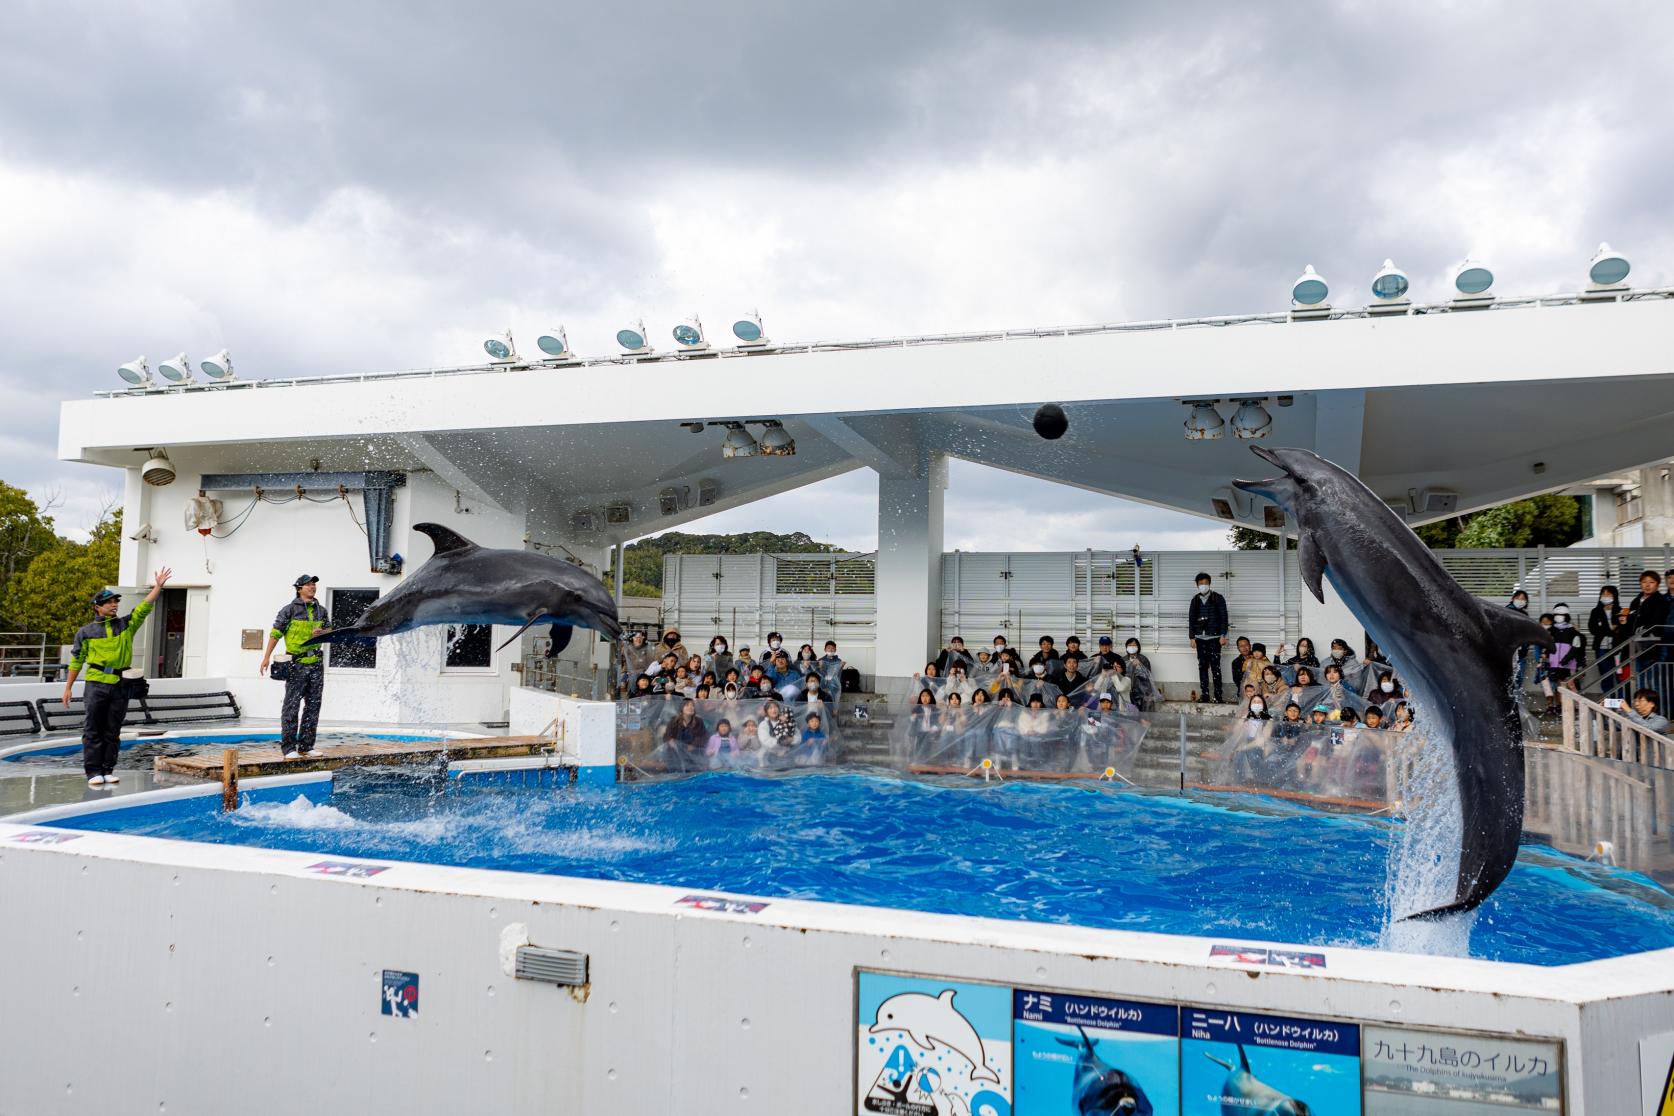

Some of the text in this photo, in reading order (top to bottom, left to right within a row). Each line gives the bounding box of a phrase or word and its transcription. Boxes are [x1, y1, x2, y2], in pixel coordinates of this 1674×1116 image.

[1023, 994, 1052, 1012] ナミ
[1023, 1010, 1043, 1020] Nami
[1192, 1013, 1241, 1032] ニーハ
[1192, 1028, 1211, 1040] Niha
[1374, 1040, 1547, 1076] 九十九島のイルカ
[1406, 1065, 1418, 1073] The
[1420, 1066, 1452, 1077] Dolphins
